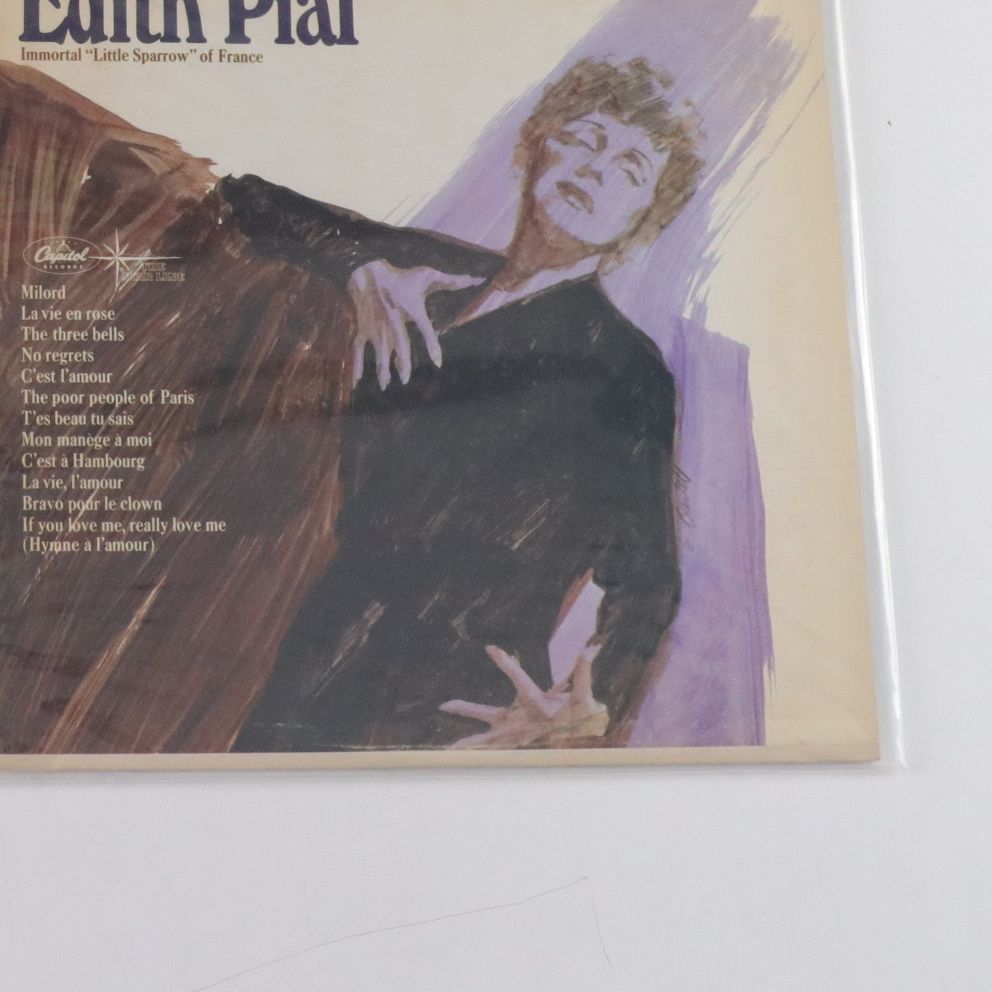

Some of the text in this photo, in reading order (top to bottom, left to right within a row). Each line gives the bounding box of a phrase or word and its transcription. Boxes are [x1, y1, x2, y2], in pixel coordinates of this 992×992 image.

[20, 46, 82, 62] Immortal
[200, 48, 214, 64] of
[218, 49, 264, 64] France
[34, 245, 90, 264] Capitol
[21, 284, 66, 300] Milord
[20, 306, 116, 321] La vie en rose
[20, 326, 125, 342] The three bells
[21, 347, 95, 365] No regrets
[20, 368, 112, 384] C'est l'amour
[20, 388, 195, 408] The poor people of Paris
[21, 410, 134, 426] T'es beau tu sais
[22, 431, 52, 447] Mon
[126, 432, 152, 447] moi
[22, 452, 56, 468] C'est
[72, 452, 146, 471] Hambourg
[22, 474, 123, 492] La vie, l'amour
[22, 496, 162, 514] Bravo pour le clown
[22, 516, 226, 535] If you love me, really love me
[22, 536, 80, 554] (Hymne
